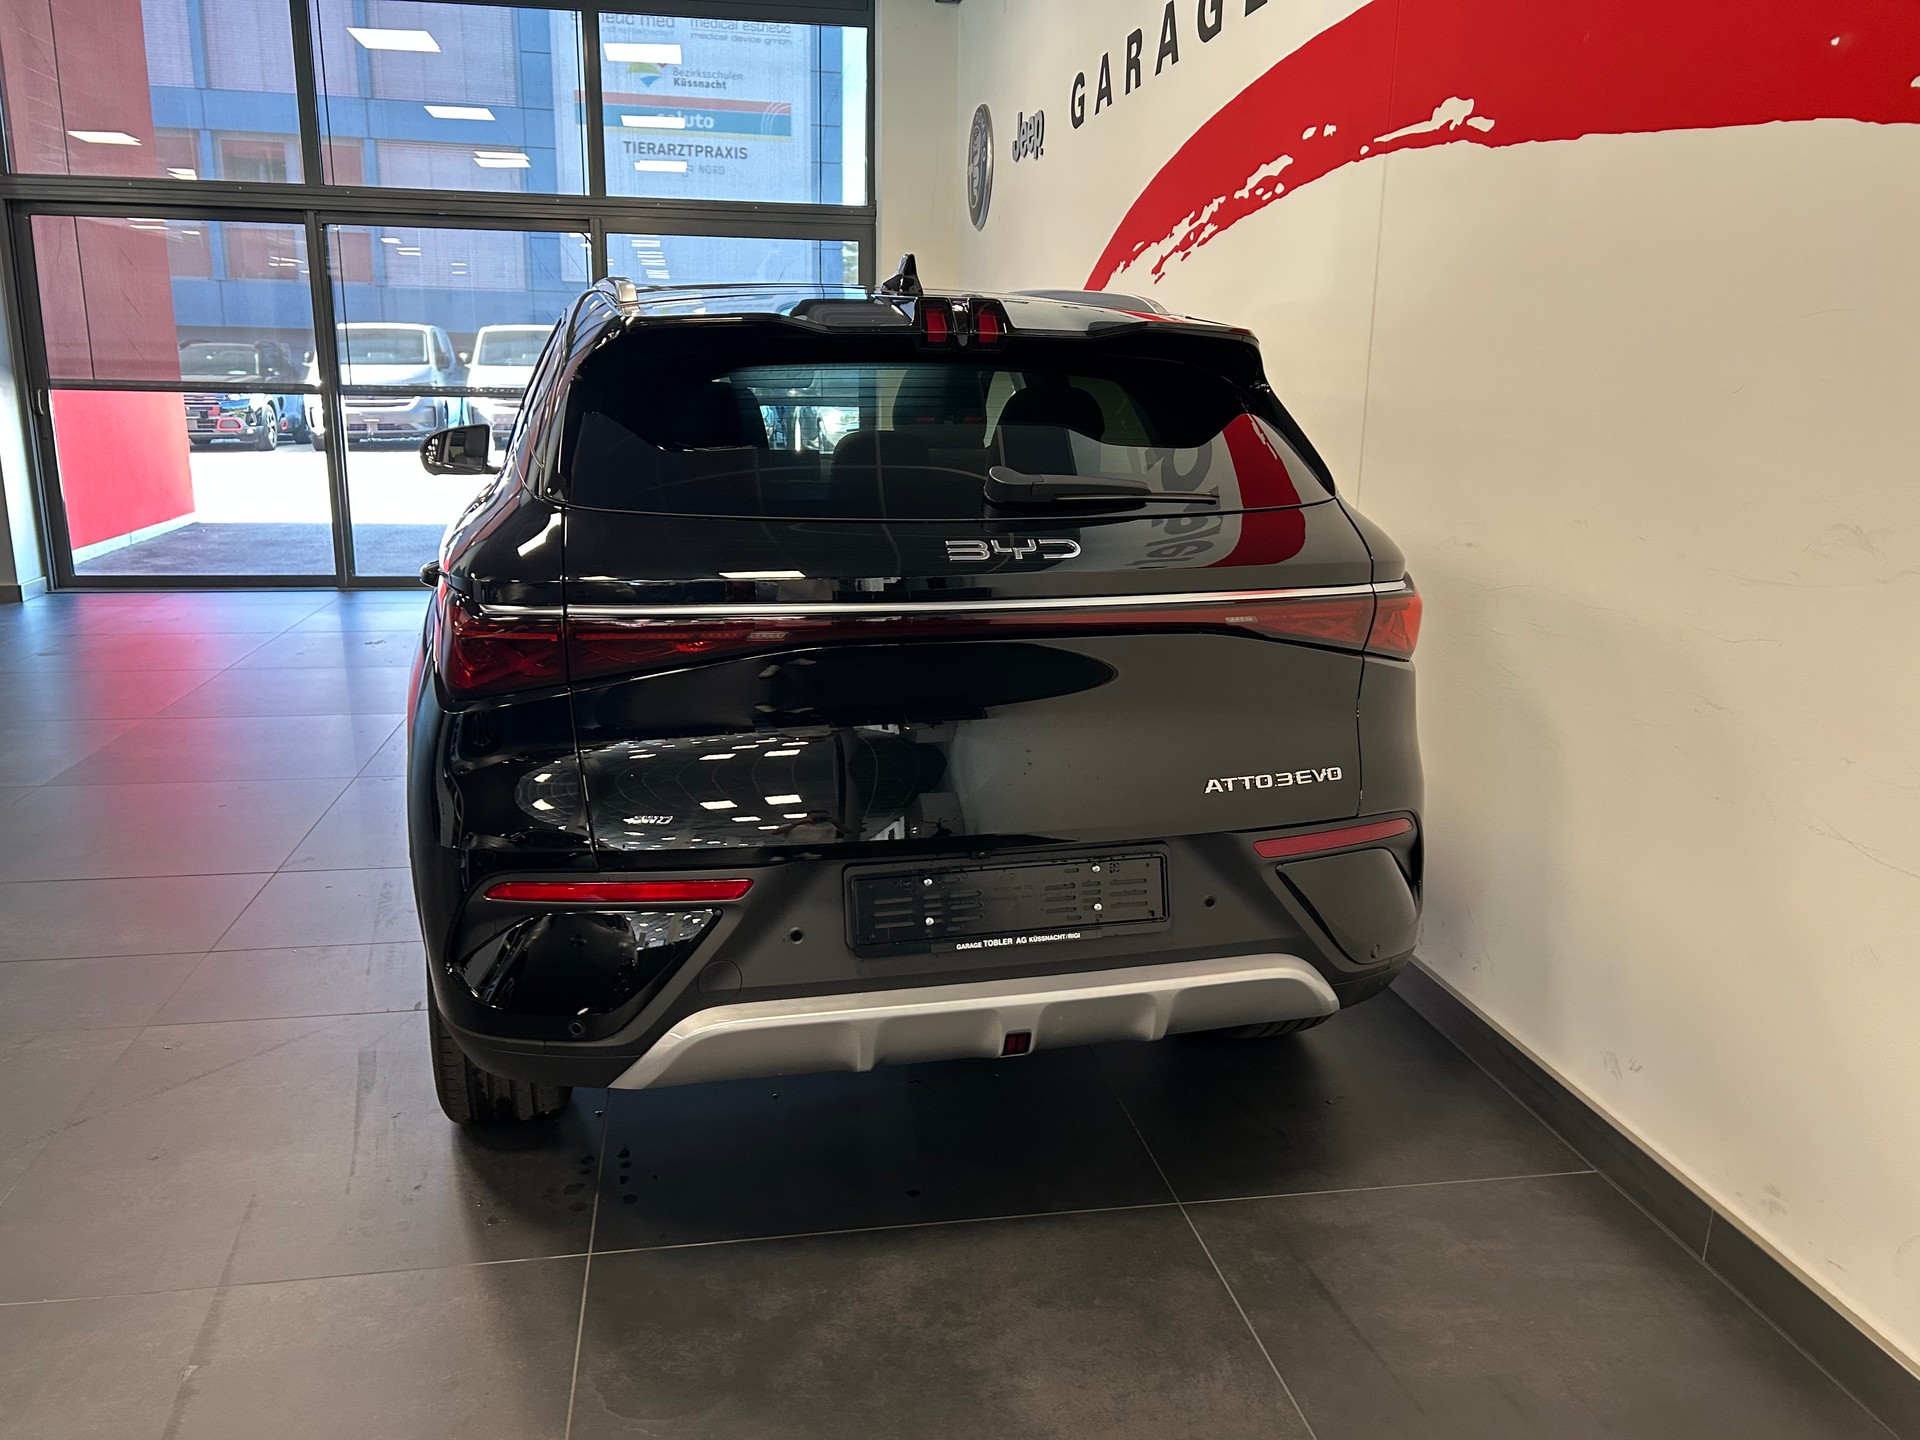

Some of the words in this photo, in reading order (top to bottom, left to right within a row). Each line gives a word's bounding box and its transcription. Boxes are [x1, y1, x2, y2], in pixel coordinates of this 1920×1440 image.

[672, 66, 744, 82] Bezirksschulen
[1070, 0, 1268, 130] GARAG
[673, 77, 728, 90] Küssnacht
[1011, 109, 1045, 163] Jeep
[623, 140, 748, 160] TIERARZTPRAXIS
[945, 538, 1082, 561] BYD
[956, 941, 983, 950] GARAGE
[983, 937, 1014, 948] TOBLER
[1015, 936, 1028, 945] AG
